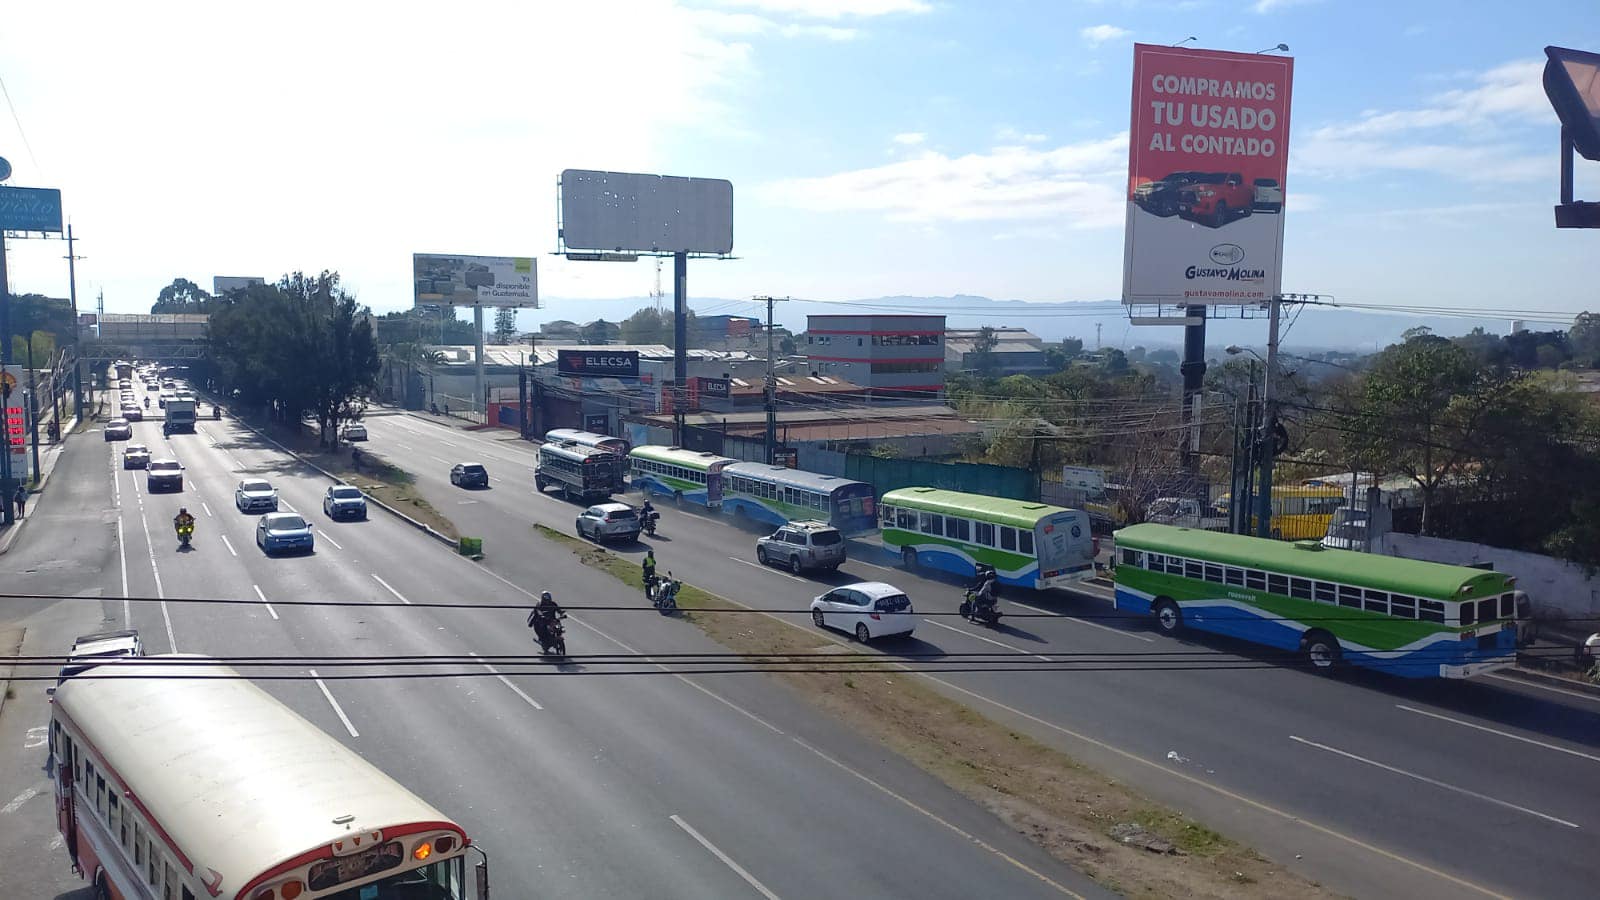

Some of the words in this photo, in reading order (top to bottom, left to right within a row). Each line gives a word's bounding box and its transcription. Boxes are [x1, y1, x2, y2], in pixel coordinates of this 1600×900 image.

[1152, 74, 1275, 101] COMPRAMOS
[1151, 101, 1184, 126] TU
[1190, 104, 1276, 131] USADO
[1149, 132, 1176, 152] AL
[1181, 134, 1276, 157] CONTADO
[1185, 266, 1228, 279] GUSTAVO
[1227, 267, 1265, 281] MOLINA
[1184, 289, 1265, 298] gustavomolina.com
[585, 357, 632, 366] ELECSA
[707, 382, 726, 391] ELECSA
